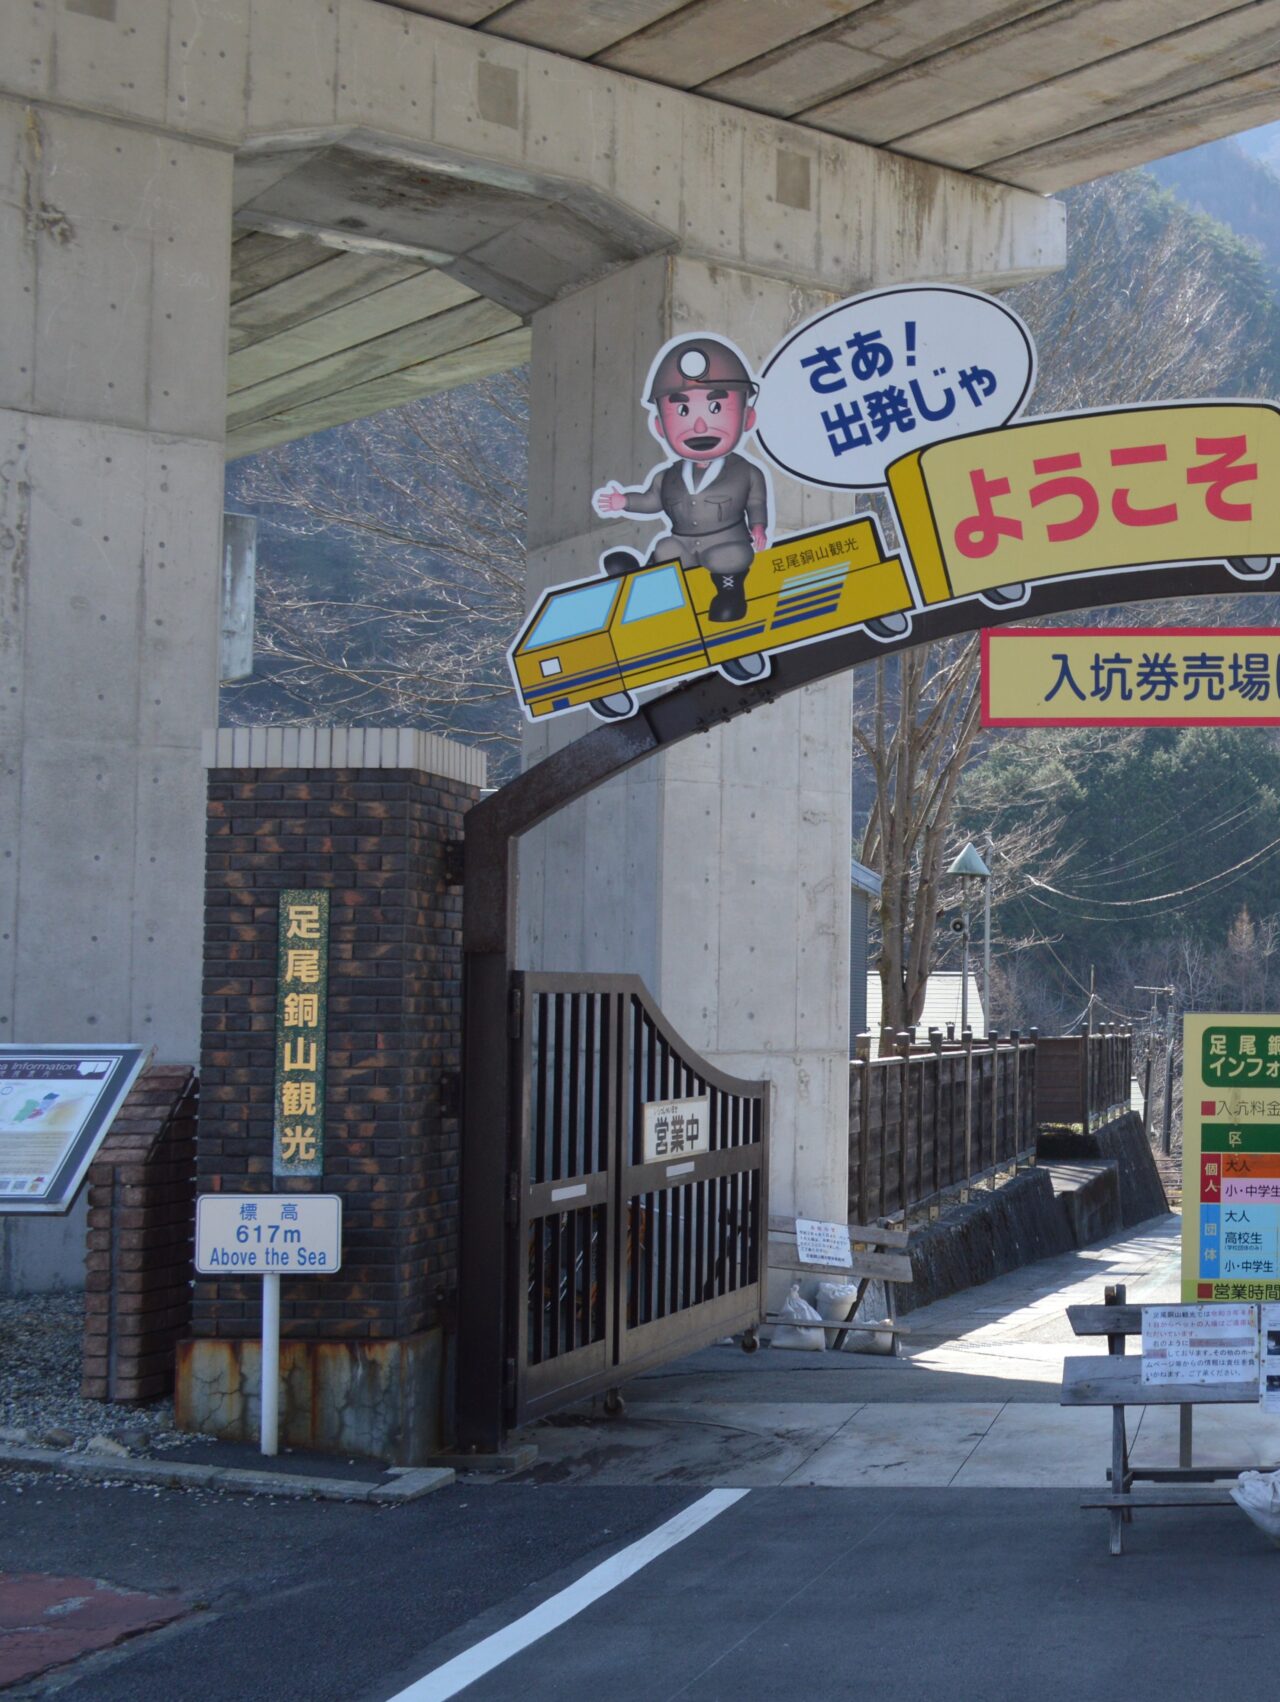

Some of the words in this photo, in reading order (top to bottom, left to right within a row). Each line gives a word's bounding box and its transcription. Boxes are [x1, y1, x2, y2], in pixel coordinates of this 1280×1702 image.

[799, 320, 918, 395] さあ！
[819, 364, 998, 457] 出発じゃ
[953, 434, 1260, 560] ようこそ
[771, 537, 860, 574] 足尾銅山観光
[281, 904, 323, 1162] 足尾銅山観光
[654, 1112, 700, 1156] 営業中
[1225, 1160, 1251, 1173] 大人
[236, 1224, 302, 1244] 617m
[1224, 1210, 1250, 1223] 大人
[1224, 1231, 1263, 1244] 高校生
[209, 1246, 258, 1267] Above
[264, 1246, 290, 1267] the
[297, 1246, 327, 1267] Sea
